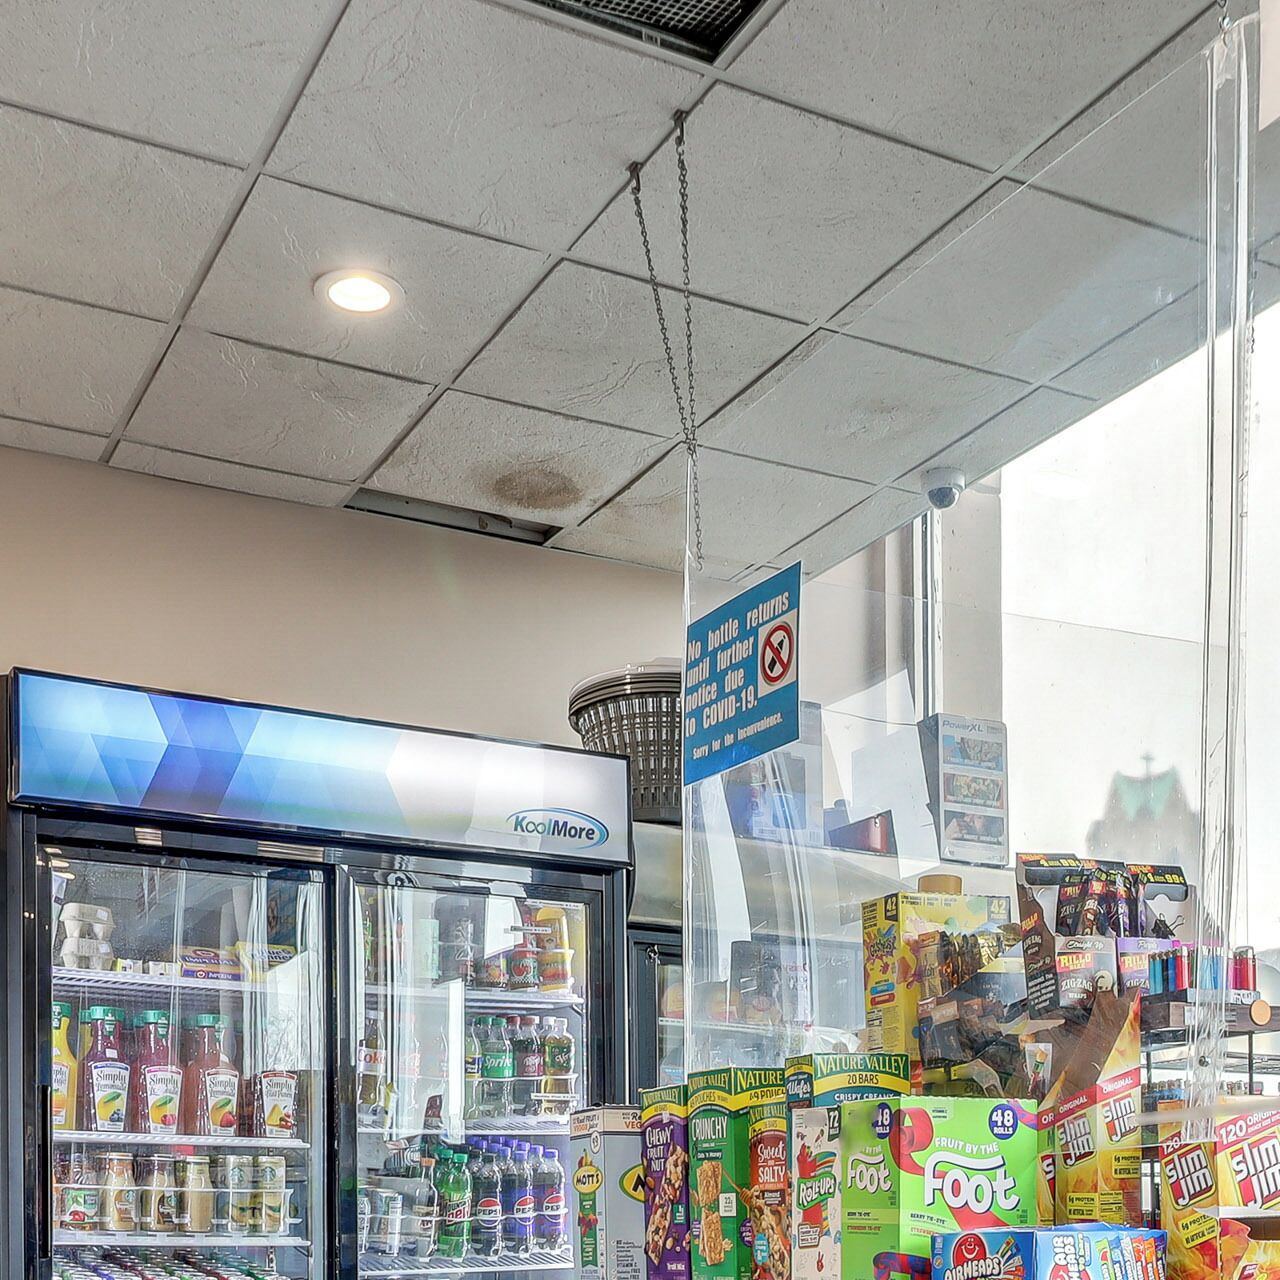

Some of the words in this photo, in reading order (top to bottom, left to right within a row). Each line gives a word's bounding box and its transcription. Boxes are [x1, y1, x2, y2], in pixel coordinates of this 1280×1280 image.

[686, 638, 701, 663] No
[707, 616, 740, 649] bottle
[746, 591, 790, 631] returns
[686, 657, 711, 688] until
[715, 635, 755, 678] further
[686, 679, 718, 712] notice
[724, 667, 745, 691] due
[686, 714, 696, 737] to
[703, 685, 759, 729] COVID-19.
[941, 719, 984, 734] PowerXL
[693, 744, 709, 760] Sorry
[711, 739, 721, 753] for
[724, 734, 735, 747] the
[513, 814, 596, 842] KoolMore
[1060, 977, 1094, 993] ZIG-ZAG
[484, 1055, 512, 1069] Sprite
[815, 1053, 867, 1074] NATURE
[866, 1054, 908, 1078] VALLEY
[149, 1073, 179, 1087] Simply
[846, 1073, 858, 1084] 20
[857, 1073, 880, 1085] BARS
[786, 1080, 812, 1099] Wafer
[1058, 1095, 1089, 1114] ORIGINAL
[991, 1107, 1015, 1127] 48
[645, 1125, 674, 1146] CHEWY
[691, 1116, 728, 1141] CRUNCHY
[993, 1126, 1014, 1136] ROLLS
[1218, 1122, 1246, 1145] 120
[646, 1144, 665, 1161] FRUIT
[757, 1141, 786, 1161] Sweet
[934, 1138, 965, 1152] FRUIT
[964, 1140, 977, 1152] BY
[977, 1141, 1000, 1154] THE
[650, 1157, 665, 1173] NUT
[757, 1165, 786, 1183] SALTY
[575, 1172, 602, 1187] MOTT'S
[1053, 1234, 1064, 1267] AIR
